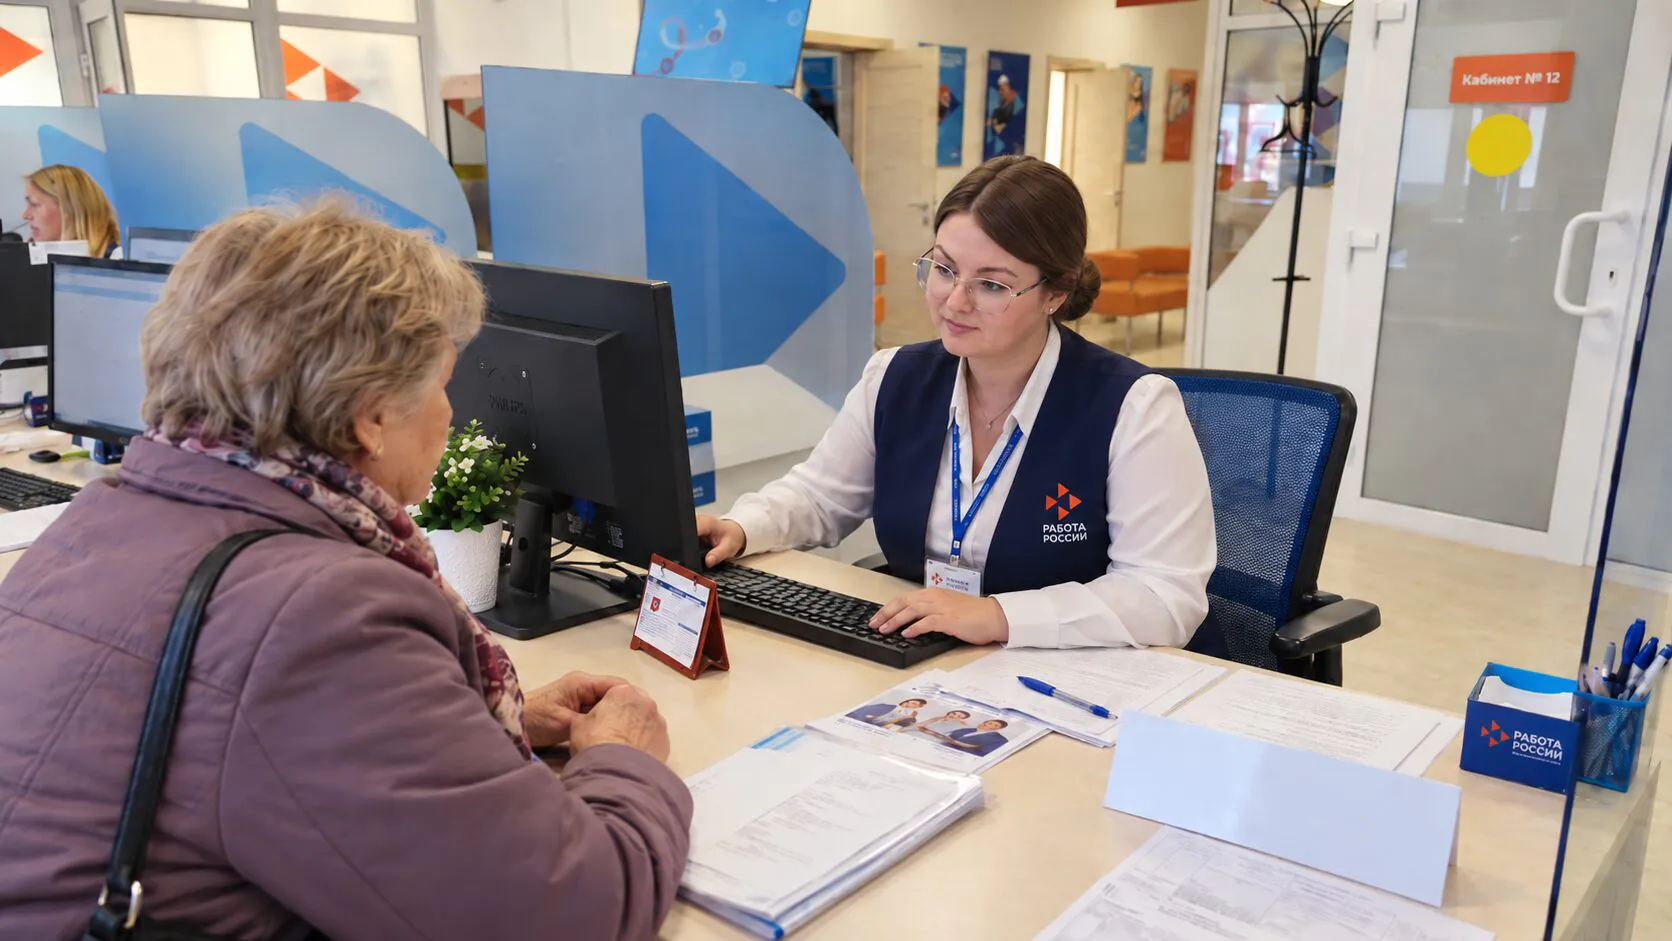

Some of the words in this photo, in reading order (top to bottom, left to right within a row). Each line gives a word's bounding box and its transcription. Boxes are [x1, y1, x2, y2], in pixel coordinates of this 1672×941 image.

[1462, 73, 1521, 86] Кабинет
[1525, 72, 1542, 84] №
[1546, 72, 1560, 84] 12
[1043, 523, 1086, 533] РАБОТА
[1043, 532, 1087, 543] РОССИИ
[1513, 731, 1562, 750] РАБОТА
[1512, 741, 1562, 761] РОССИИ
